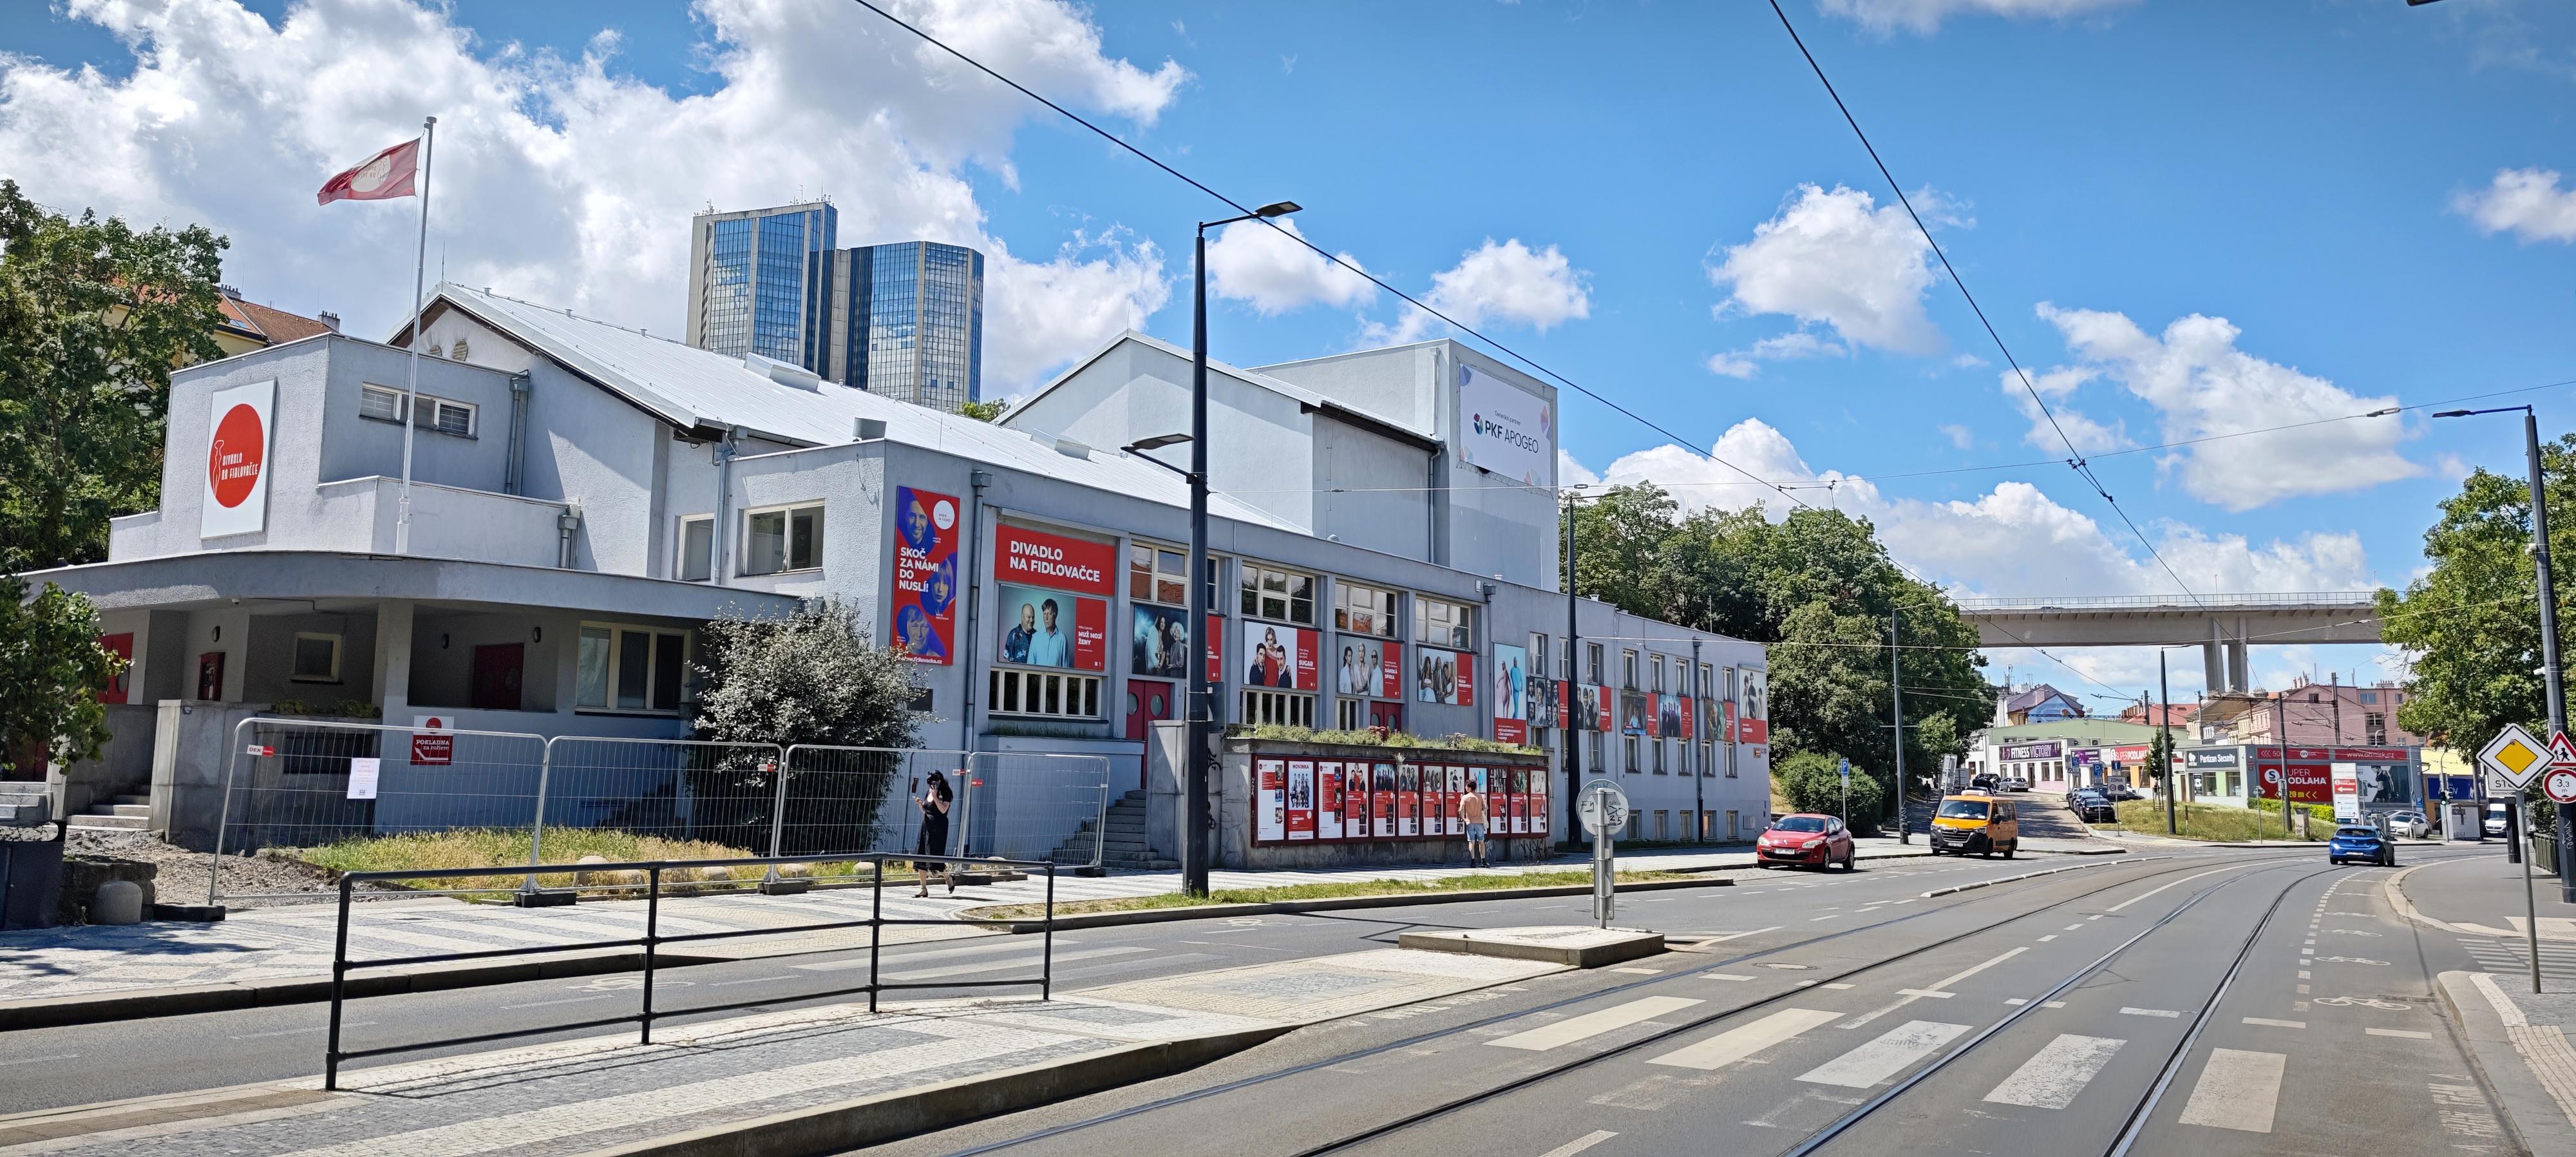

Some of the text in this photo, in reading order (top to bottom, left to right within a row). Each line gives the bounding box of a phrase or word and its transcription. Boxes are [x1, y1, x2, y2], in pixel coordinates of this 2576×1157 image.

[1485, 420, 1539, 453] PKF APOGEO
[222, 452, 242, 466] DIVADLO
[222, 462, 258, 480] NA FIDLOVAČCE
[900, 547, 926, 559] SKOČ
[1010, 540, 1063, 561] DIVADLO
[900, 558, 939, 572] ZA NÁMI
[1010, 556, 1100, 582] NA FIDLOVAČCE
[899, 569, 914, 579] DO
[899, 580, 929, 593] NUSLÍ!
[2011, 745, 2052, 759] FITNESS VICTORY
[1843, 761, 1847, 770] P
[2200, 754, 2235, 764] Partizan Security
[2269, 770, 2275, 781] S
[2556, 779, 2570, 788] 3.3
